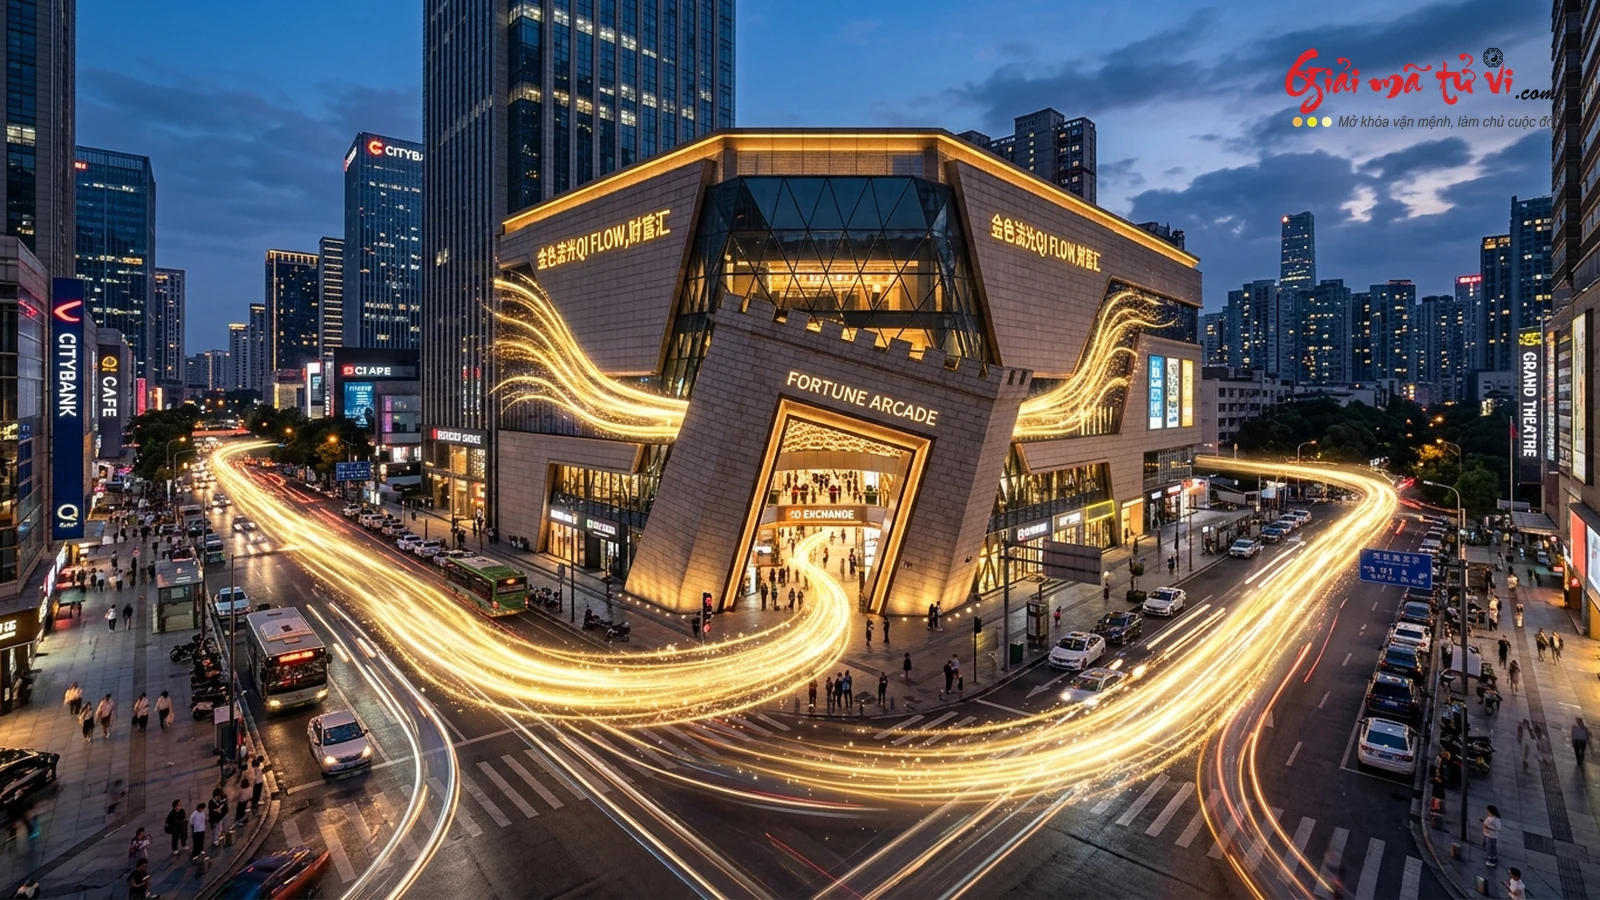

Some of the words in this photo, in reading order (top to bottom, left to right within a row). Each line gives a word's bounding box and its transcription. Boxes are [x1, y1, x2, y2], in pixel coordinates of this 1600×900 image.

[58, 333, 77, 417] CITYBANK
[102, 376, 118, 417] CAFE
[786, 371, 868, 406] FORTUNE
[869, 395, 938, 426] ARCADE
[1523, 352, 1538, 397] GRAND
